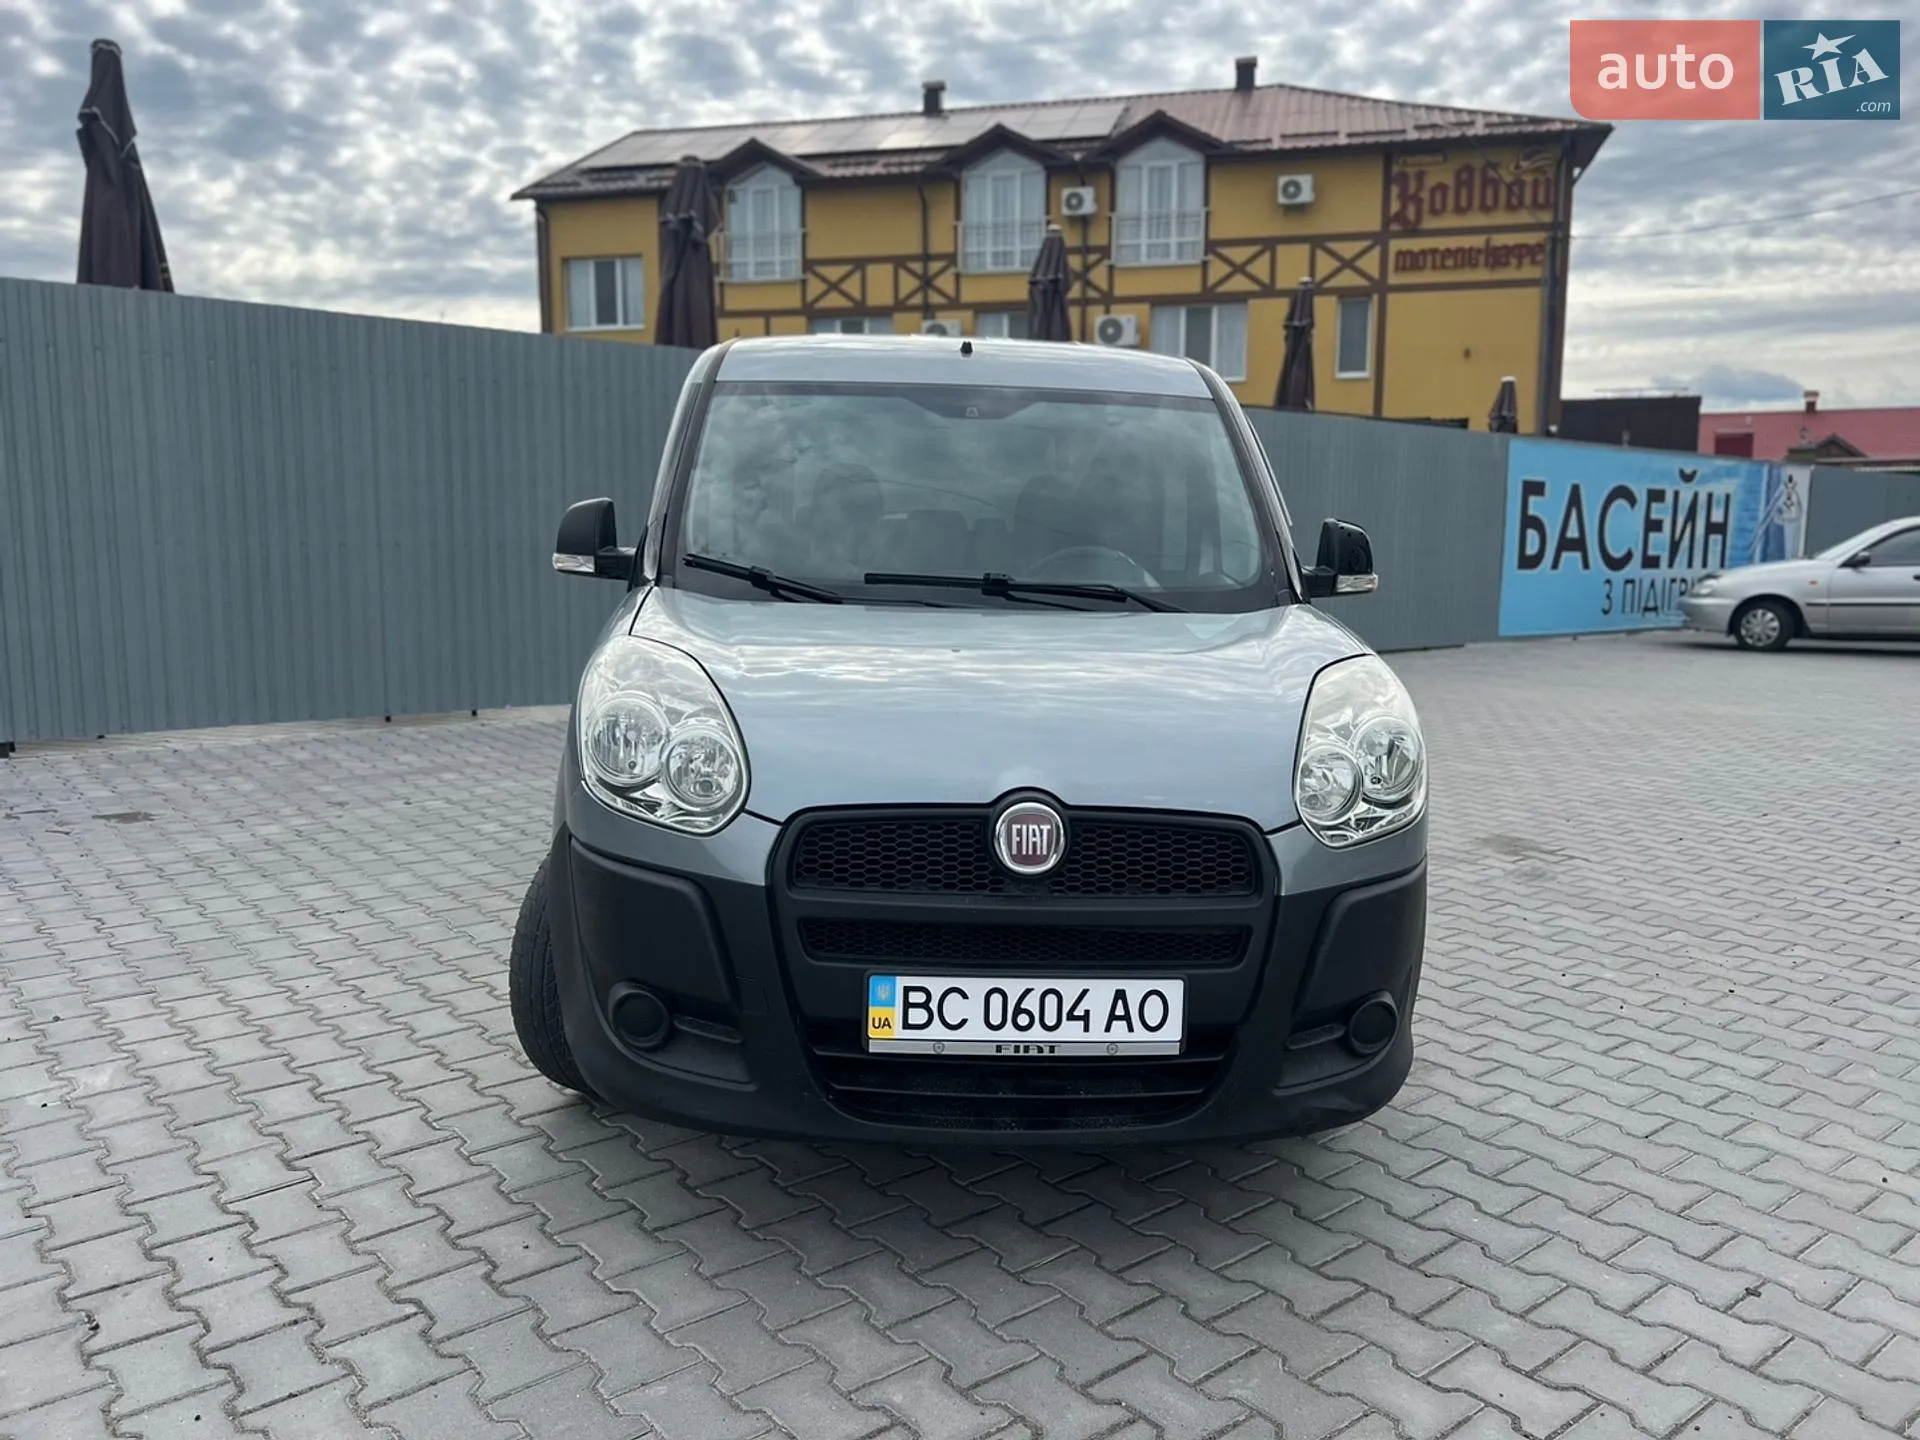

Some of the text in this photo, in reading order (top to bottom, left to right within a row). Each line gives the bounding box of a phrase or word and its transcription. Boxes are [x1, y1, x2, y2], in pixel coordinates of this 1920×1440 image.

[1517, 467, 1731, 571] БАСЕЙН
[1620, 577, 1695, 617] ПІДІГР
[1011, 824, 1052, 856] FIAT
[872, 1016, 892, 1030] UA
[902, 985, 1170, 1033] BC 0604 AO
[995, 1043, 1060, 1055] FIAT
